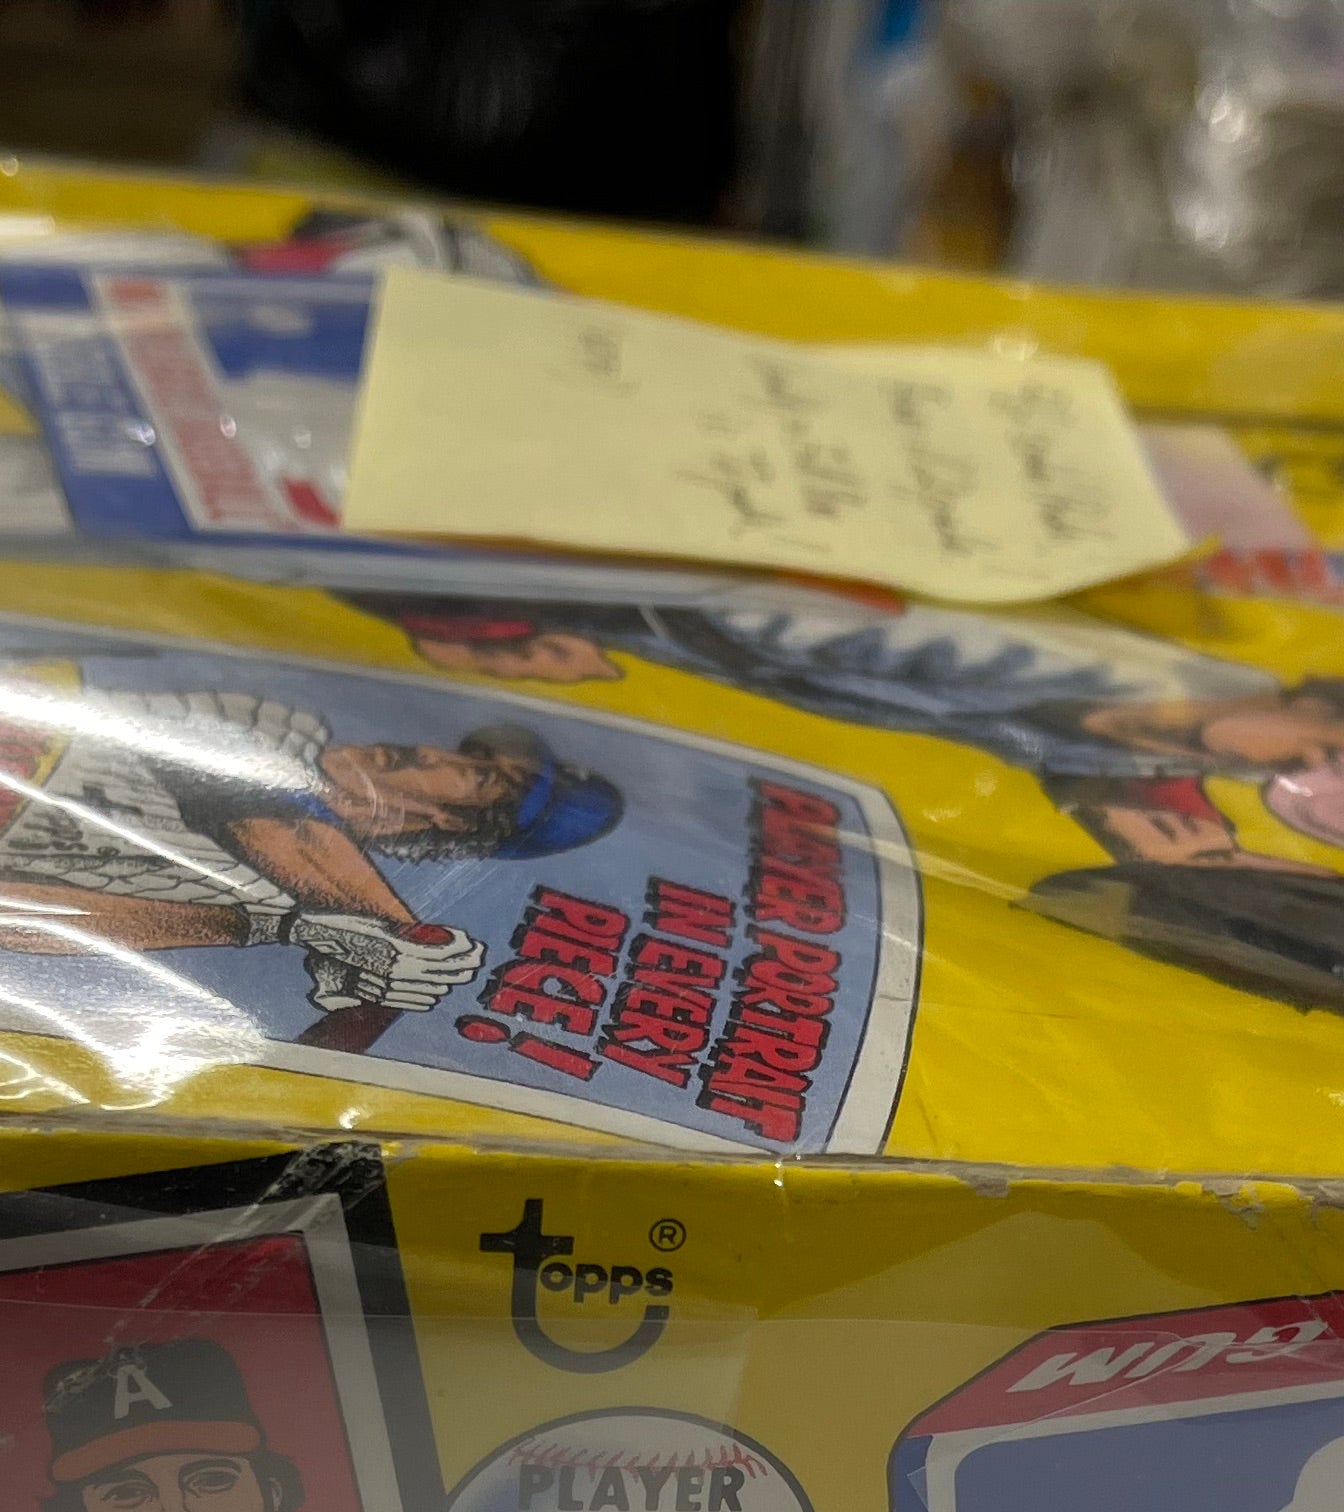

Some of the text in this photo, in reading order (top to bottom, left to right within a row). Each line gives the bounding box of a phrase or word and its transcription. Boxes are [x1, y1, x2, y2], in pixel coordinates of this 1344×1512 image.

[594, 876, 736, 1089] IN EVERY
[696, 776, 847, 1142] PLAYER PORTRAIT
[1007, 1321, 1326, 1393] GUM
[518, 1464, 745, 1512] PLAYER
